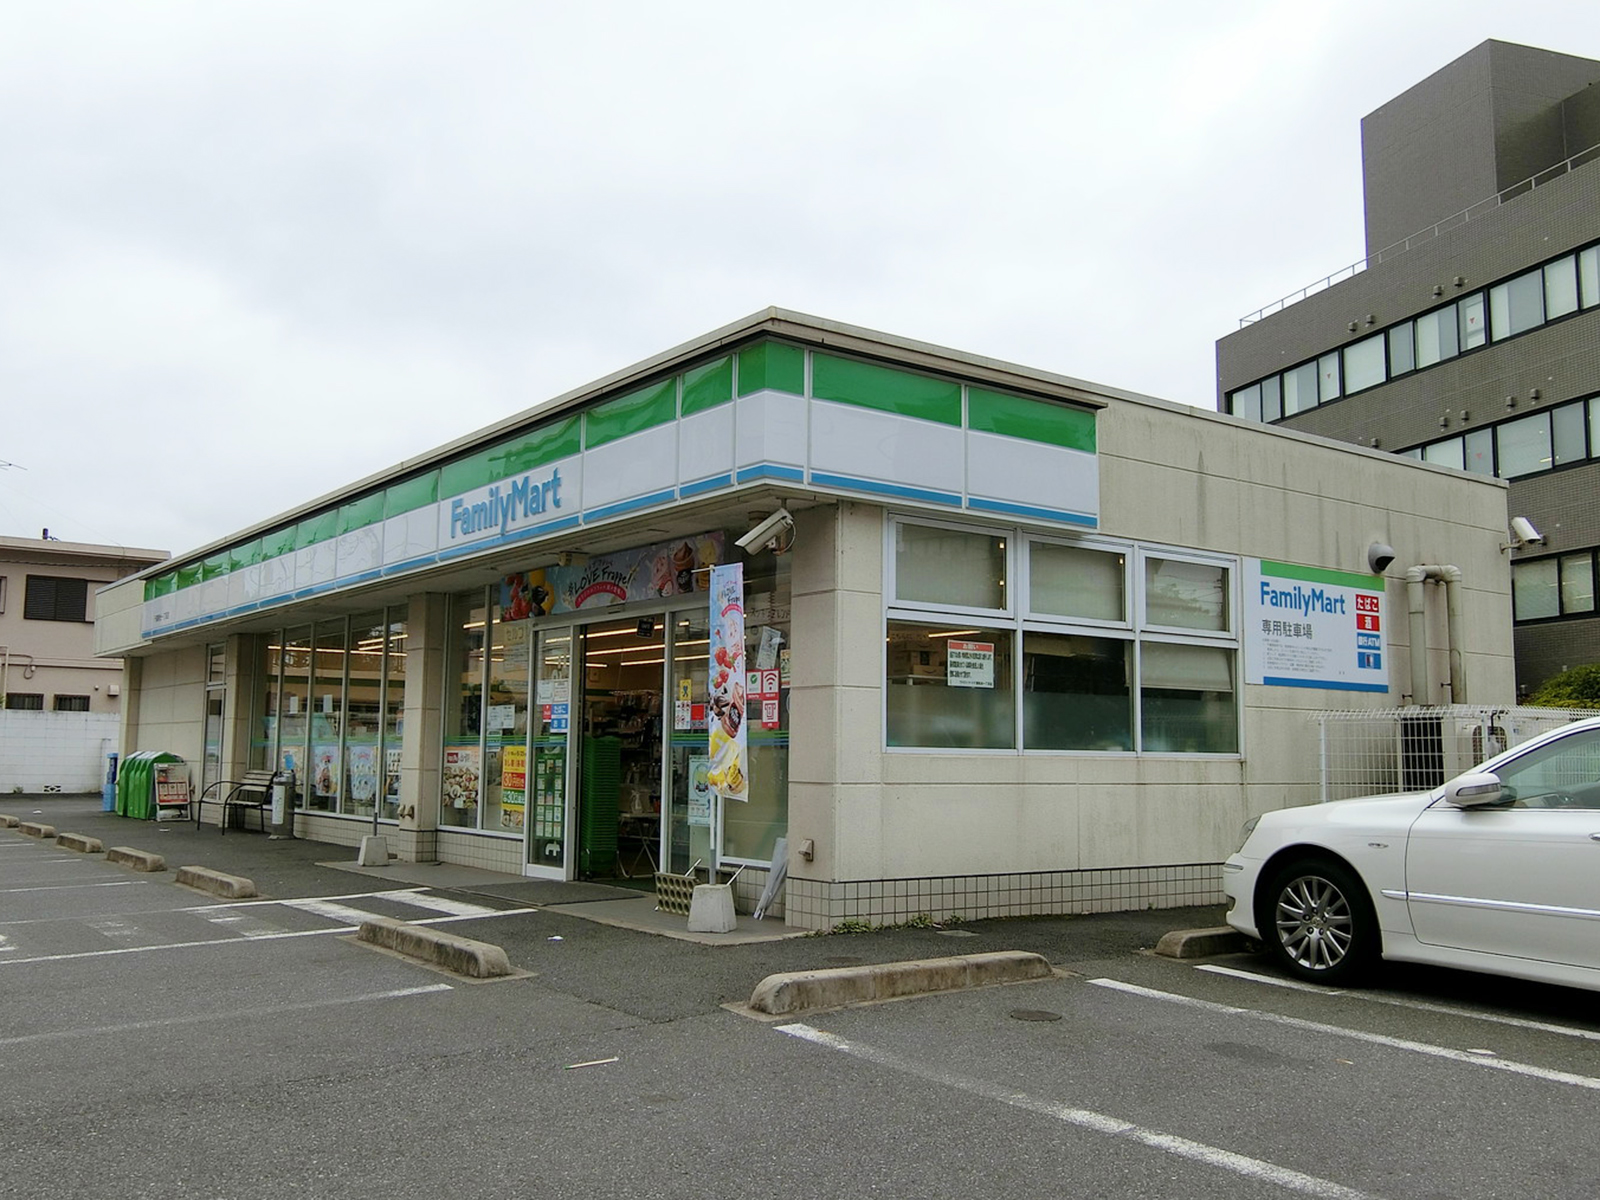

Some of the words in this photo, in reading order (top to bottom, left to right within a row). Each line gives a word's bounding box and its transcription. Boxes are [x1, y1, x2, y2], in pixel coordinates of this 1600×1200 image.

[451, 467, 562, 538] FamilyMart
[1260, 581, 1346, 617] FamilyMart
[1356, 595, 1379, 611] たばこ
[1262, 619, 1313, 640] 専用駐車場
